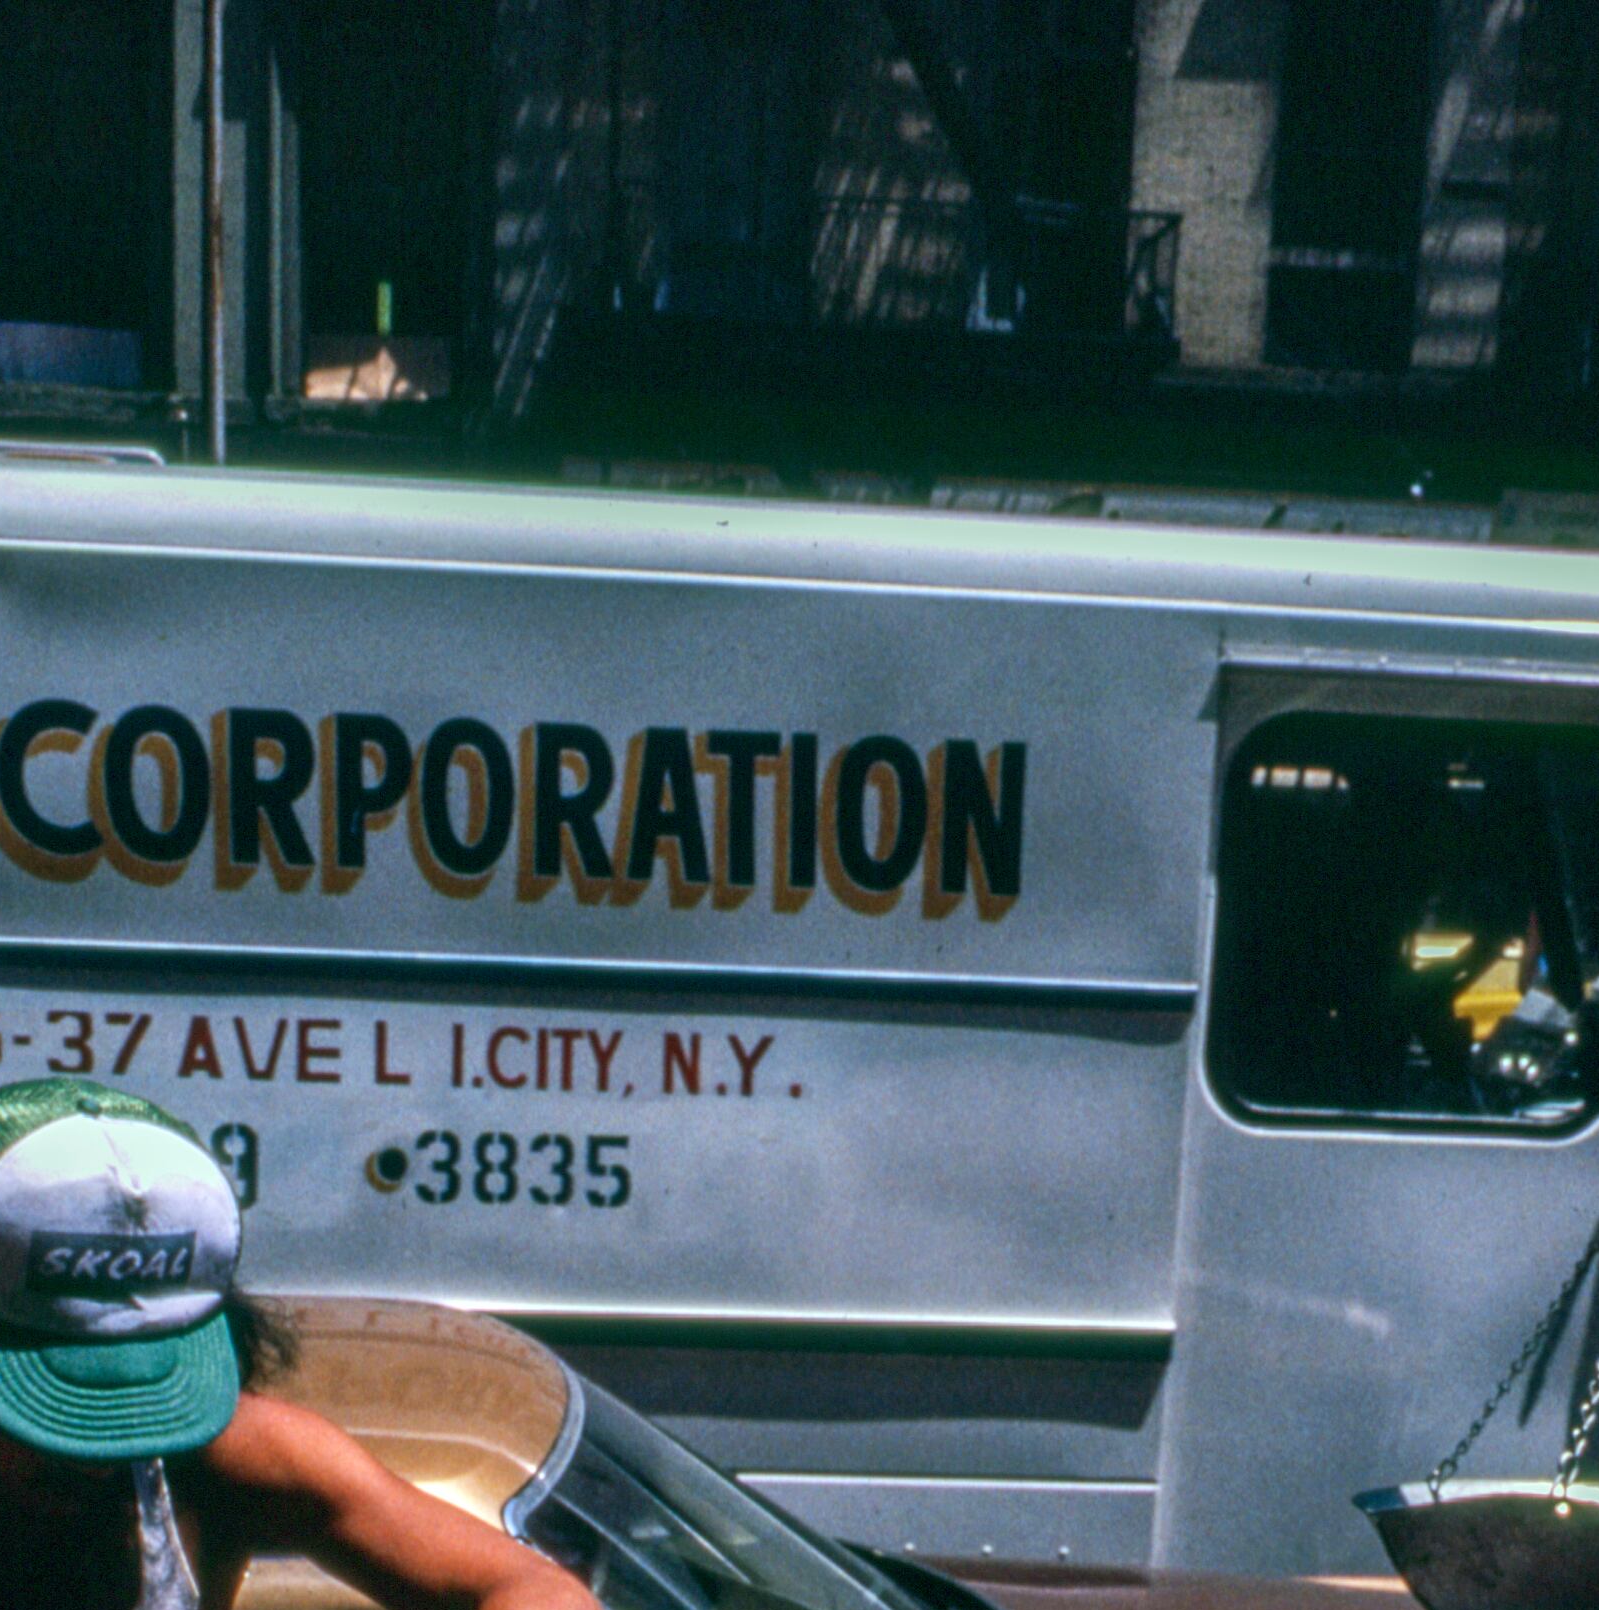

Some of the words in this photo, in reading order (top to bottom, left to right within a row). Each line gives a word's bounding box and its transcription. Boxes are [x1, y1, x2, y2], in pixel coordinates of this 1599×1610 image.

[178, 1014, 342, 1083] AVE
[414, 1129, 634, 1208] 3835
[42, 1246, 189, 1280] SKOAL
